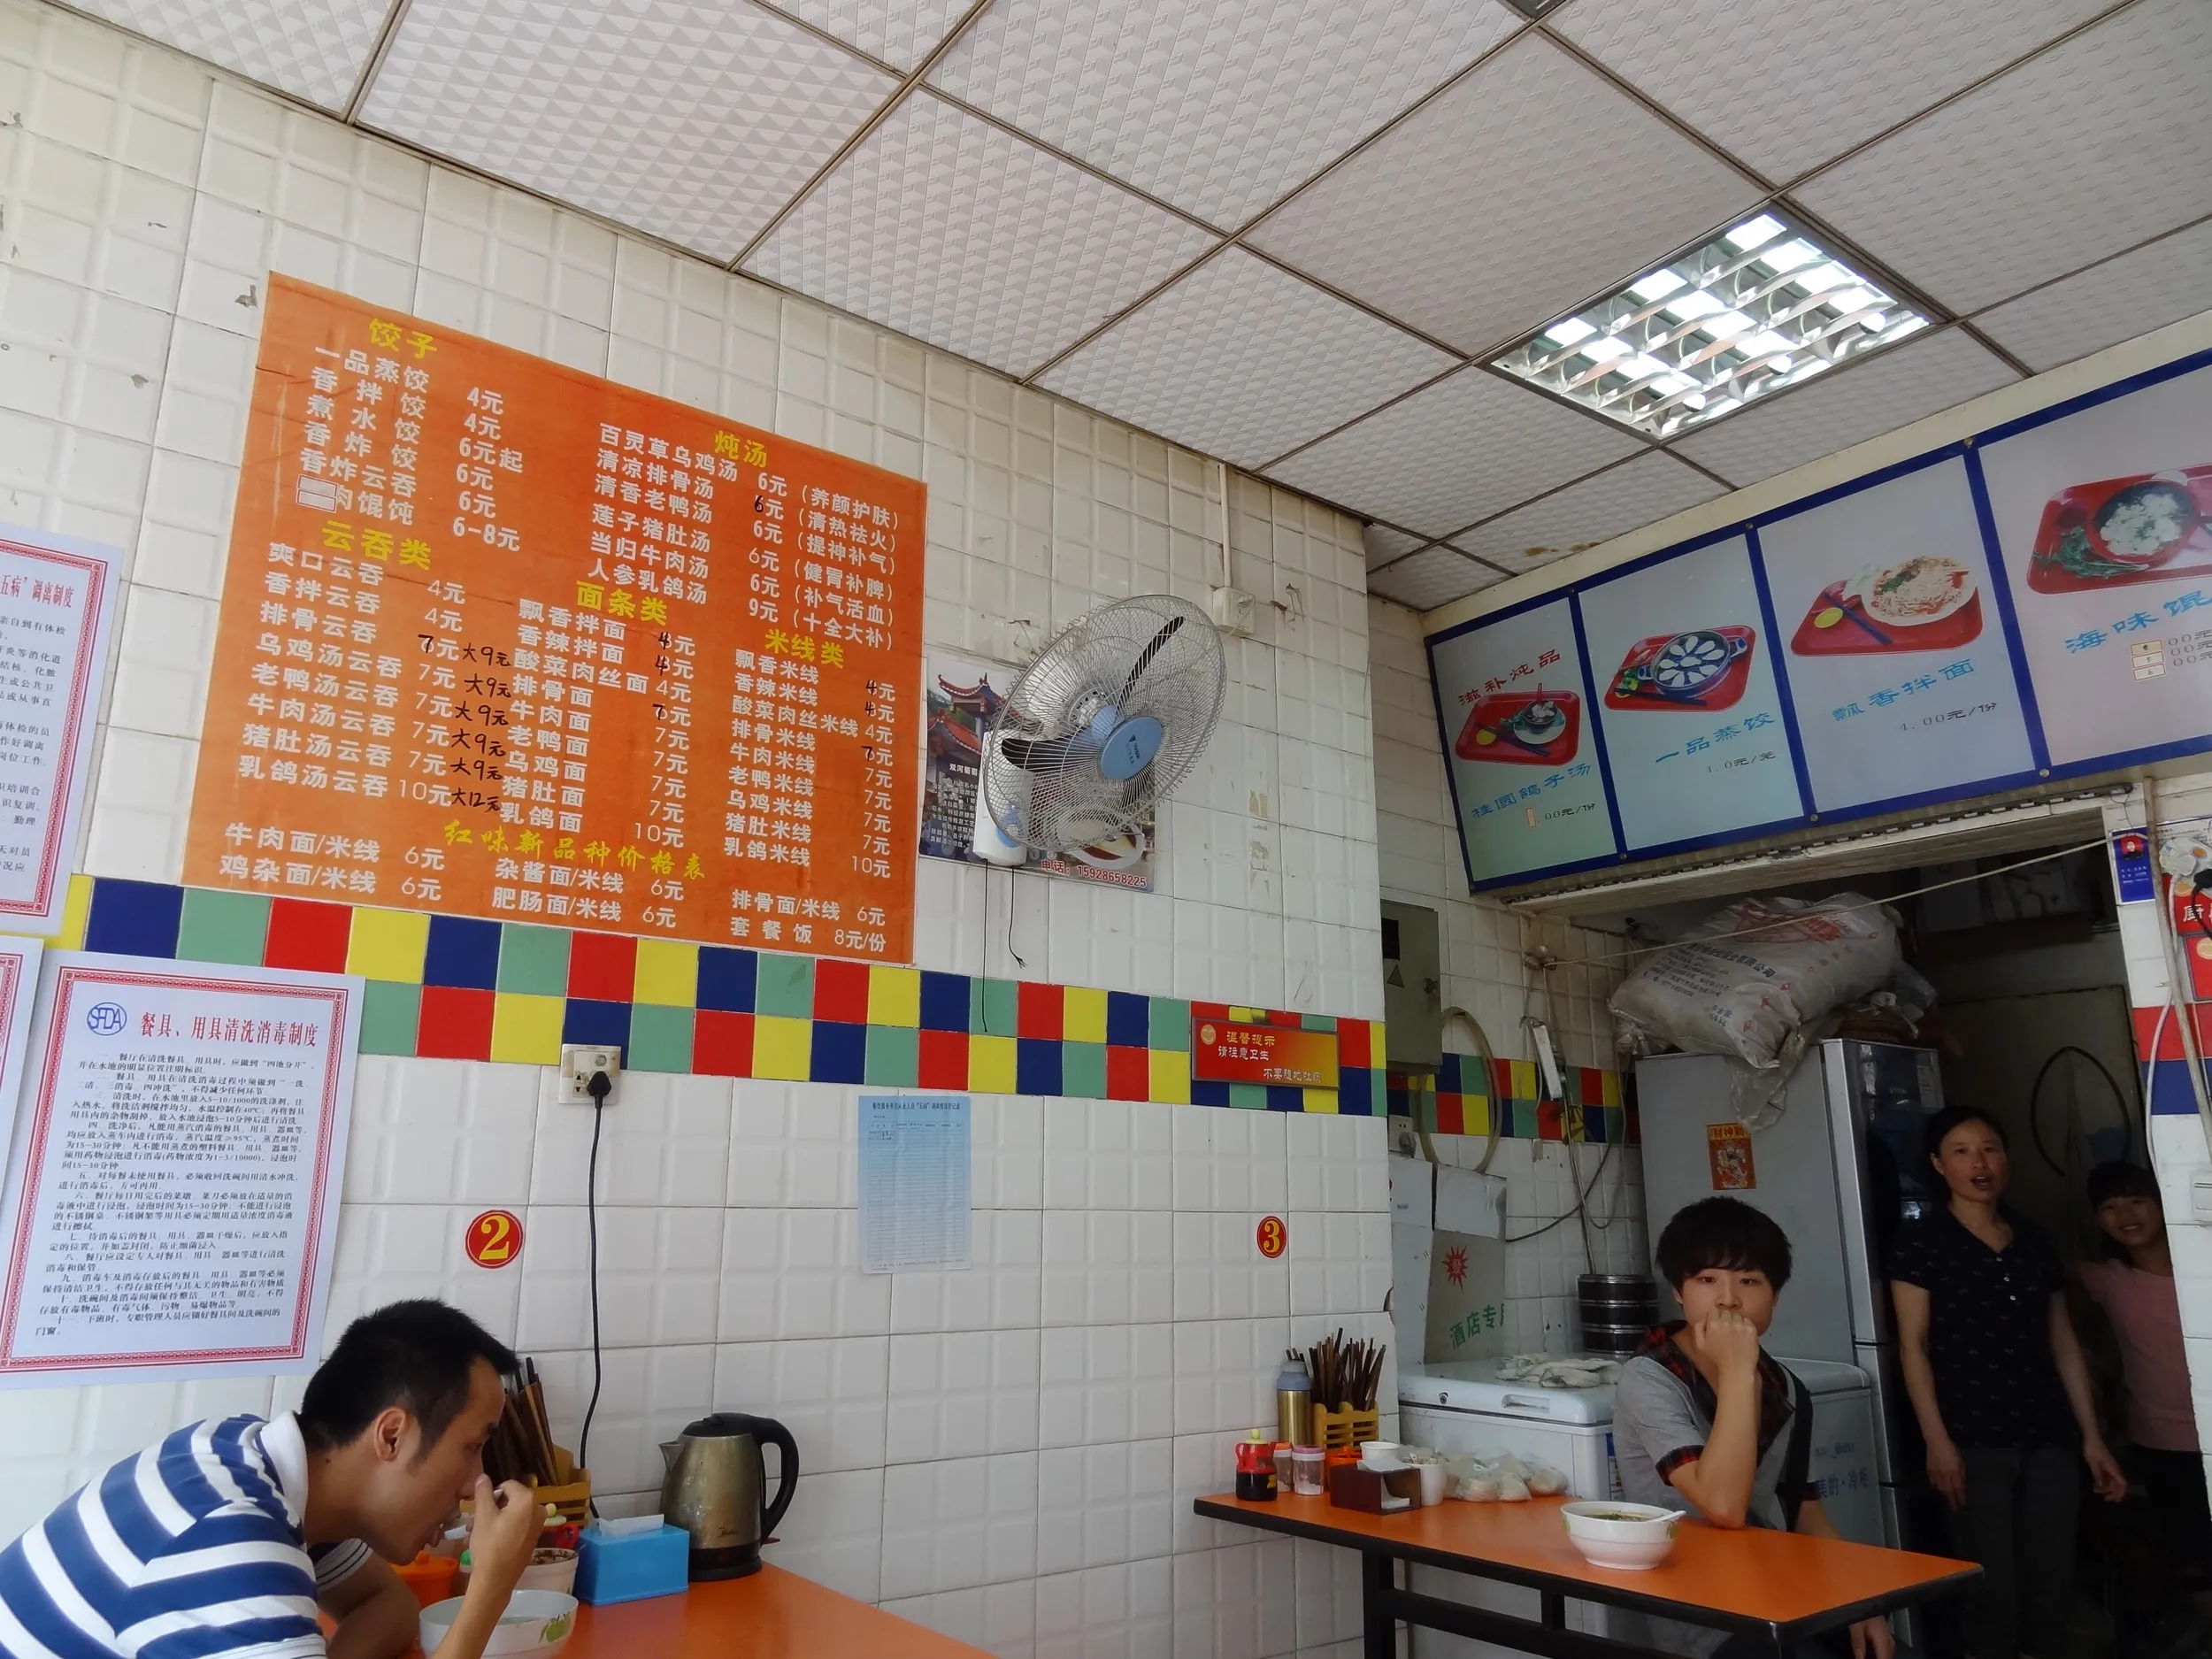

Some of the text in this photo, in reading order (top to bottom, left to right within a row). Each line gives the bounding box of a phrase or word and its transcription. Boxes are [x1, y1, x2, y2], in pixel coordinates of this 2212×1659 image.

[368, 318, 437, 358] 饺子
[311, 366, 502, 442] 香拌饺 4元
[315, 347, 505, 416] 一品蒸饺 4元
[303, 420, 495, 491] 香炸饺 6元
[307, 395, 525, 474] 煮水饺 6元起
[714, 430, 768, 469] 炖汤
[300, 447, 496, 519] 香炸云吞 6元
[596, 448, 714, 500] 清凉排骨汤
[600, 422, 738, 483] 百灵草乌鸡汤
[757, 472, 787, 497] 6元
[594, 473, 712, 525] 清香老鸭汤
[753, 519, 783, 545] 6元
[321, 519, 432, 571] 云吞类
[592, 503, 710, 553] 莲子猪肚汤
[749, 549, 780, 573] 6元
[268, 541, 466, 605] 爽口云吞 4元
[590, 532, 709, 580] 当归牛肉汤
[750, 574, 780, 599] 6元
[265, 571, 463, 634] 香拌云吞 4元
[576, 580, 667, 626] 面条类
[588, 559, 707, 605] 人参乳鸽汤
[749, 598, 779, 624] 9元
[260, 601, 377, 645] 排骨云吞
[518, 598, 626, 641] 飘香拌面
[256, 633, 456, 689] 乌鸡汤云吞 7元
[517, 624, 625, 664] 香辣拌面
[735, 649, 819, 685] 飘香米线
[764, 628, 844, 669] 米线类
[251, 662, 452, 718] 老鸭汤云吞 7元
[512, 674, 594, 708] 排骨面
[513, 648, 692, 703] 酸菜肉丝面 4元
[734, 672, 818, 707] 香辣米线
[1458, 649, 1561, 705] 滋补炖品
[1832, 658, 1974, 722] 飘香拌面
[248, 693, 449, 747] 牛肉汤云吞 7元
[510, 700, 689, 750] 牛肉面 7元
[732, 695, 894, 745] 酸菜肉丝米线 4元
[732, 718, 816, 751] 排骨米线
[1655, 712, 1775, 764] 一品蒸饺
[242, 723, 447, 775] 猪肚汤云吞 7元
[507, 725, 687, 775] 老鸭面 7元
[730, 742, 892, 789] 牛肉米线 7元
[239, 755, 451, 807] 乳鸽汤云吞 10元
[504, 751, 687, 799] 乌鸡面 7元
[729, 765, 892, 811] 老鸭米线 7元
[502, 776, 685, 824] 猪肚面 7元
[727, 788, 891, 833] 乌鸡米线 7元
[225, 822, 444, 871] 牛肉面/米线 6元
[499, 801, 684, 849] 乳鸽面 10元
[726, 813, 890, 856] 猪肚米线 7元
[219, 855, 441, 902] 鸡杂面/米线 6元
[495, 857, 685, 902] 杂酱面/米线 6元
[724, 836, 890, 879] 乳鸽米线 10元
[1077, 865, 1148, 887] 15928658225
[491, 887, 677, 929] 肥肠面/米线 6元
[731, 915, 812, 944] 套餐饭
[732, 888, 886, 926] 排骨面/米线 6元
[1217, 1045, 1270, 1061] 请注意卫生
[479, 1215, 510, 1260] 2
[1263, 1220, 1280, 1253] 3
